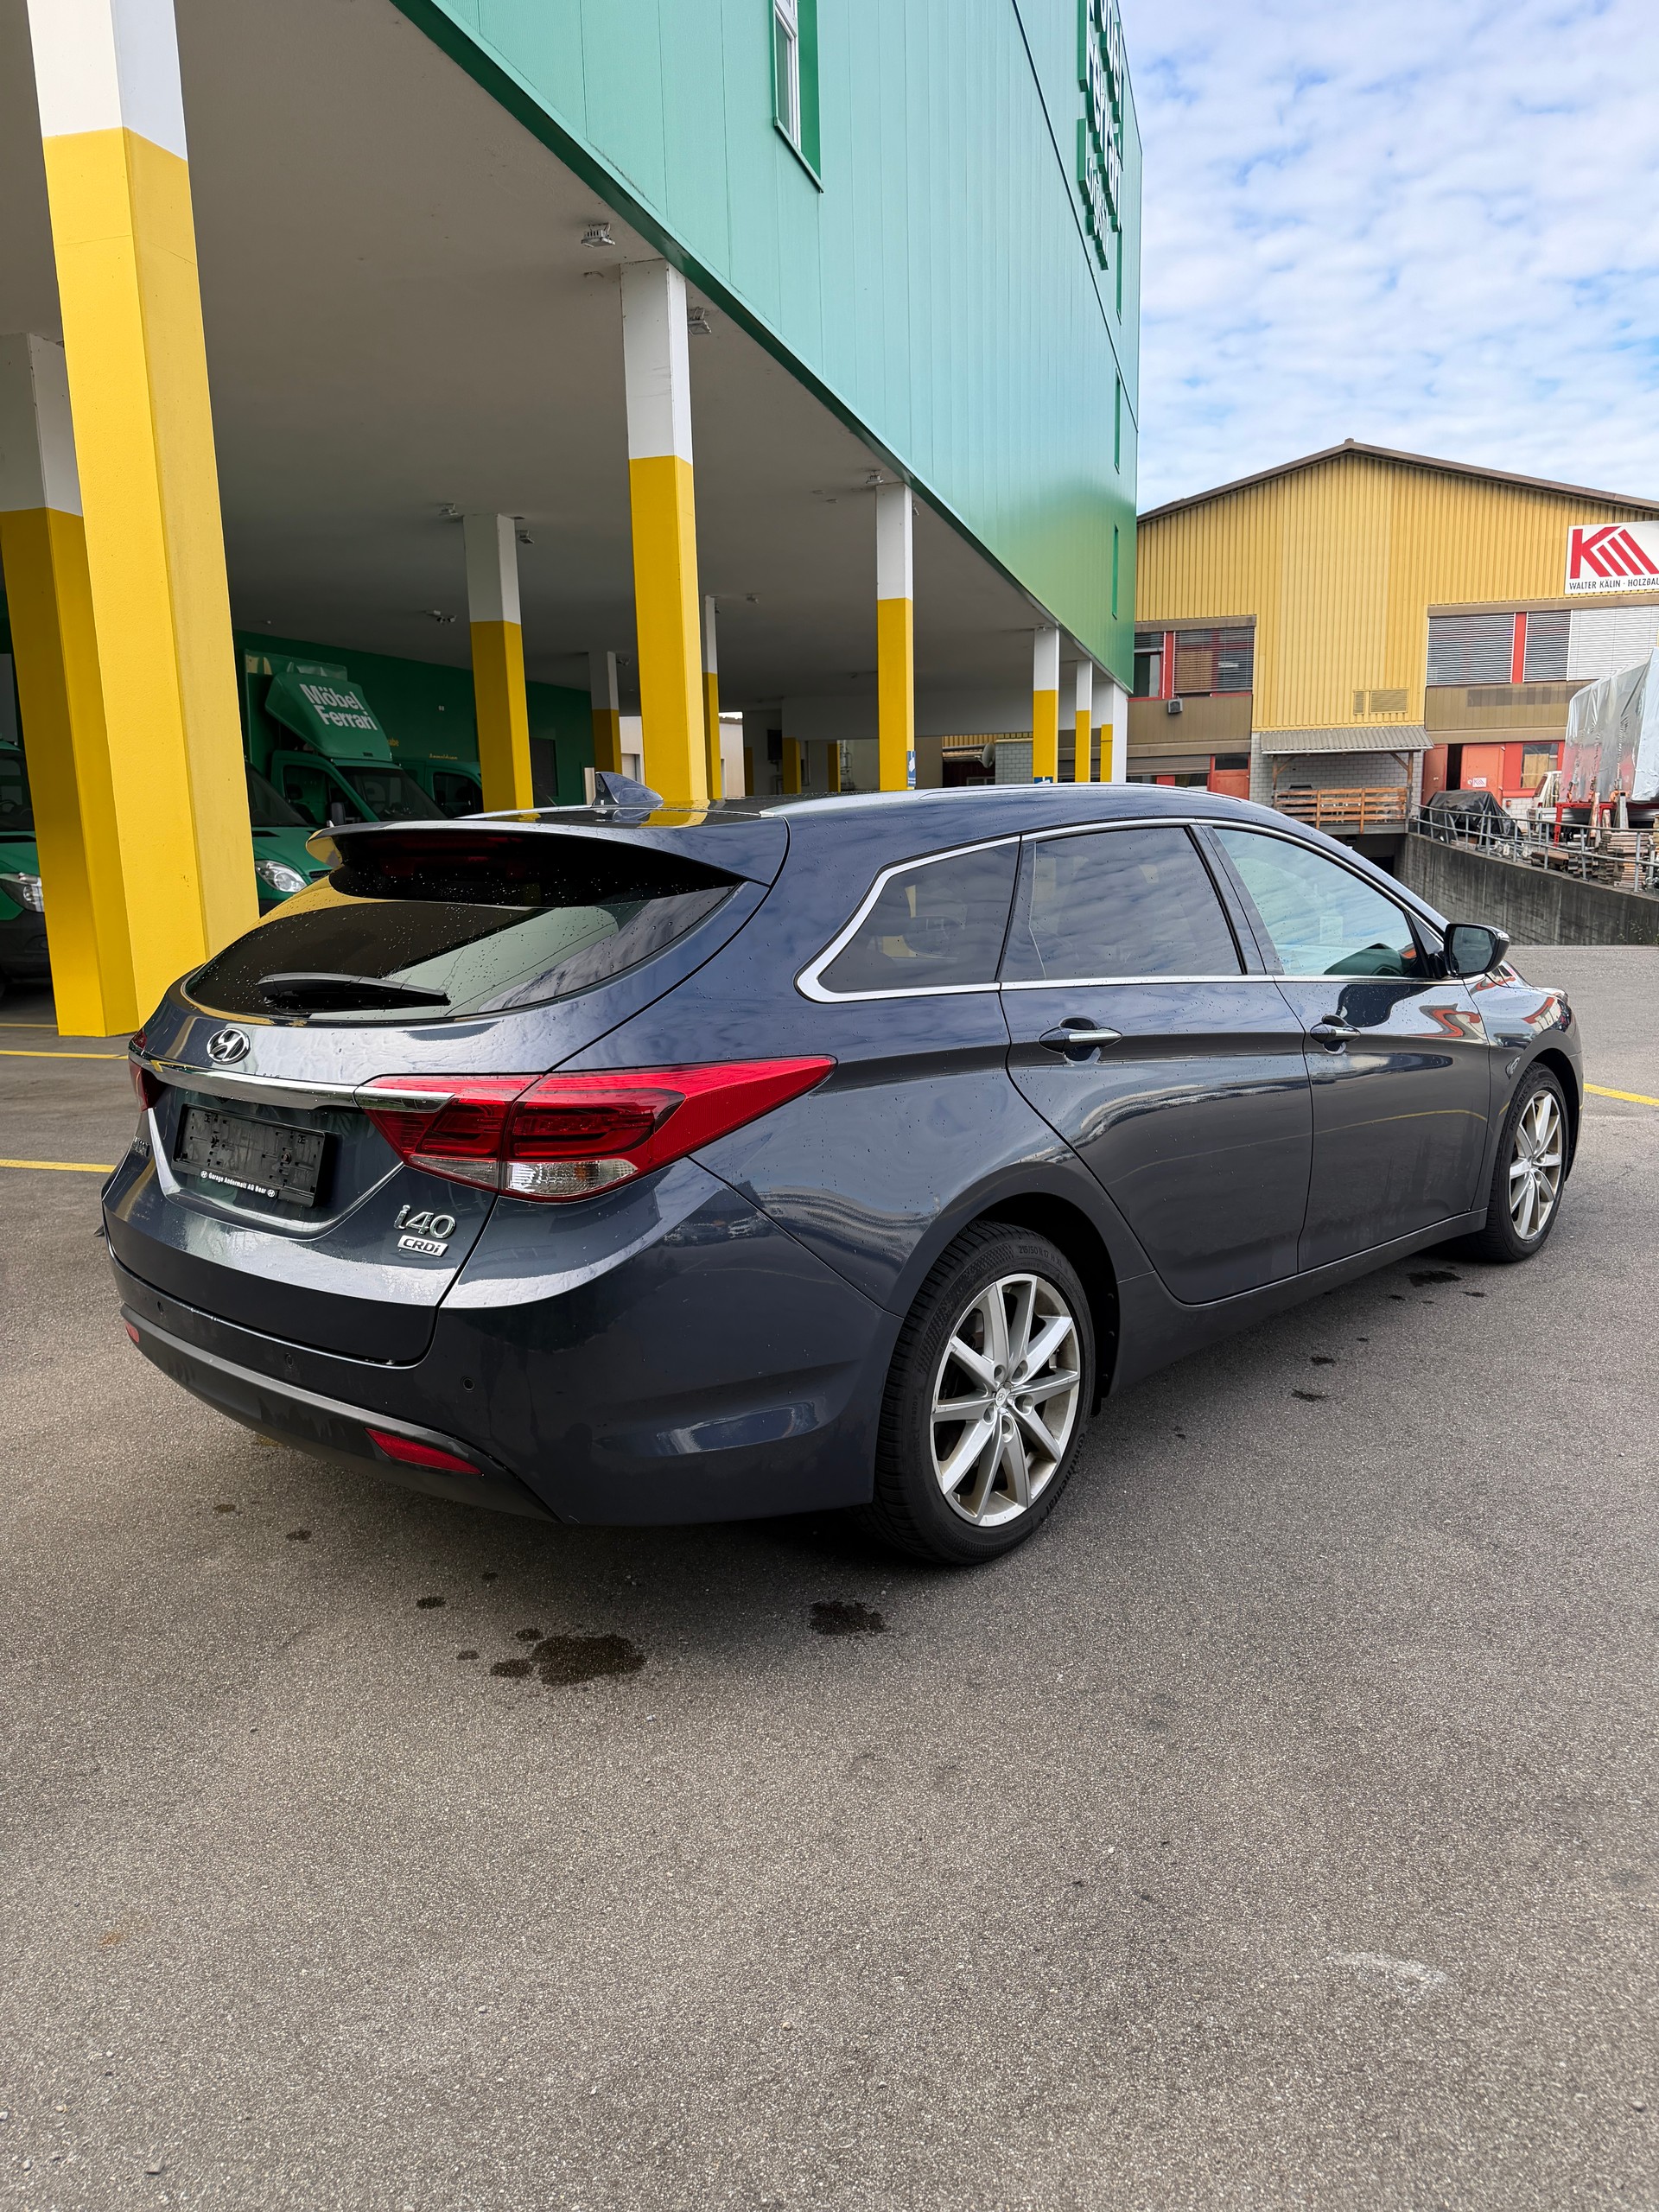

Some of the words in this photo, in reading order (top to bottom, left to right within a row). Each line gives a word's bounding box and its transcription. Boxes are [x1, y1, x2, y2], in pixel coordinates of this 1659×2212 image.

[1569, 582, 1597, 590] WALTER
[1599, 579, 1621, 588] KÄLIN
[299, 683, 365, 710] Möbel
[314, 704, 378, 730] Ferrari
[1509, 1089, 1528, 1131] POLARIS
[208, 1173, 224, 1182] Garage
[224, 1177, 247, 1189] Andermatt
[394, 1205, 456, 1239] i40
[403, 1238, 442, 1254] CRDi
[1046, 1433, 1086, 1516] Continental
